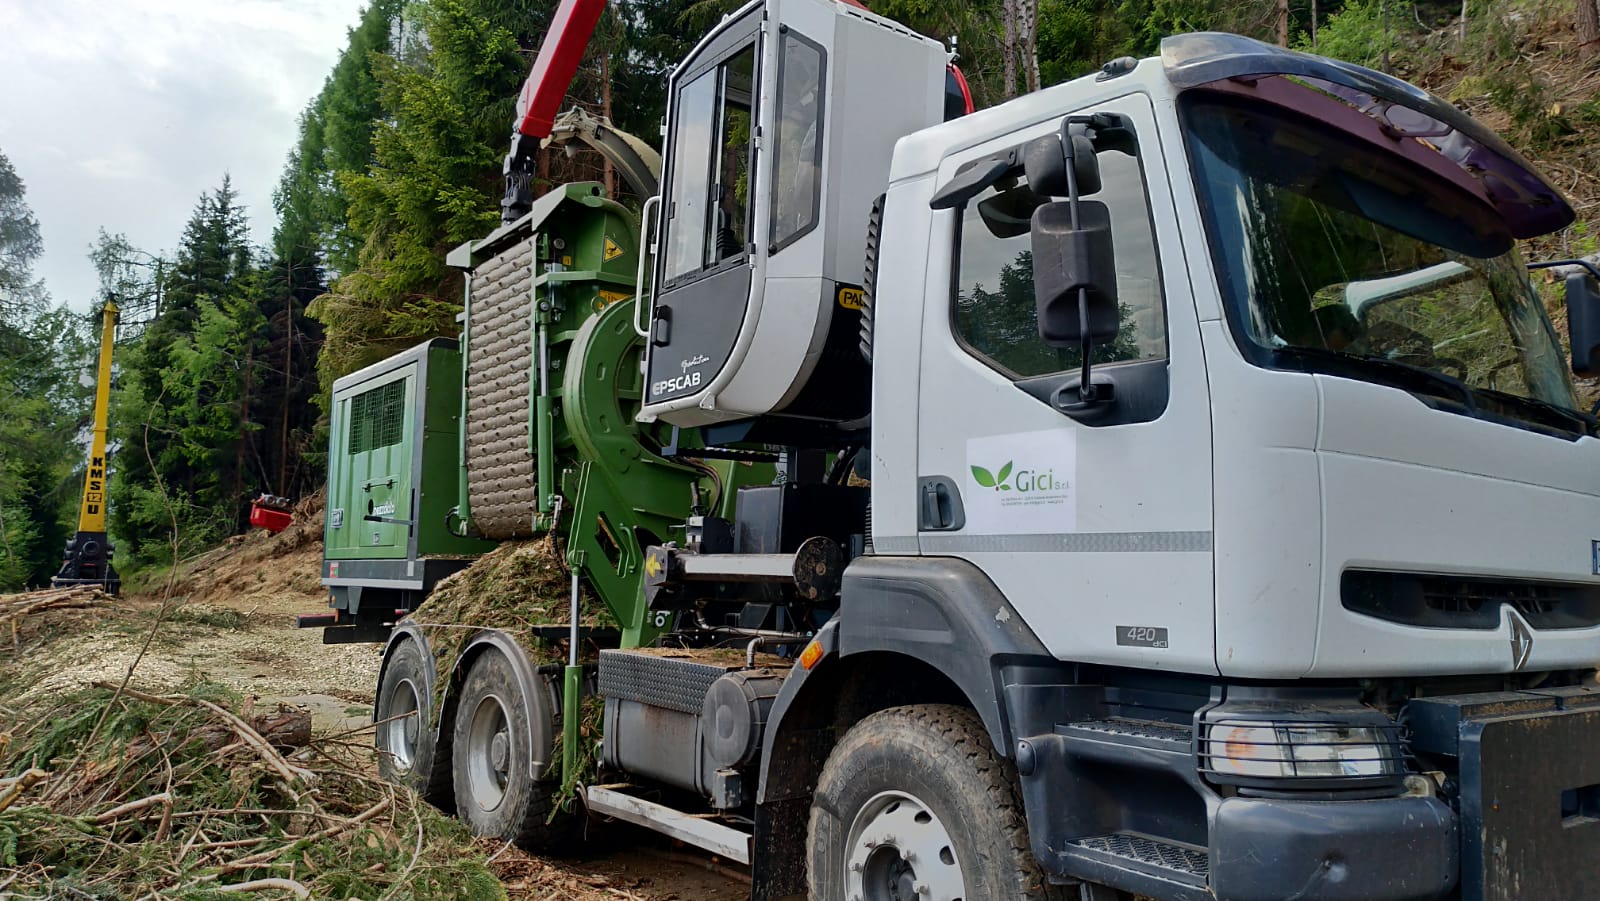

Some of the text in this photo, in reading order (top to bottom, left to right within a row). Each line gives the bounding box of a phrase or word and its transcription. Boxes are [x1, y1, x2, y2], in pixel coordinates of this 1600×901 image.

[652, 372, 701, 395] EPSCAB
[1015, 468, 1053, 492] Gici
[1127, 627, 1156, 642] 420
